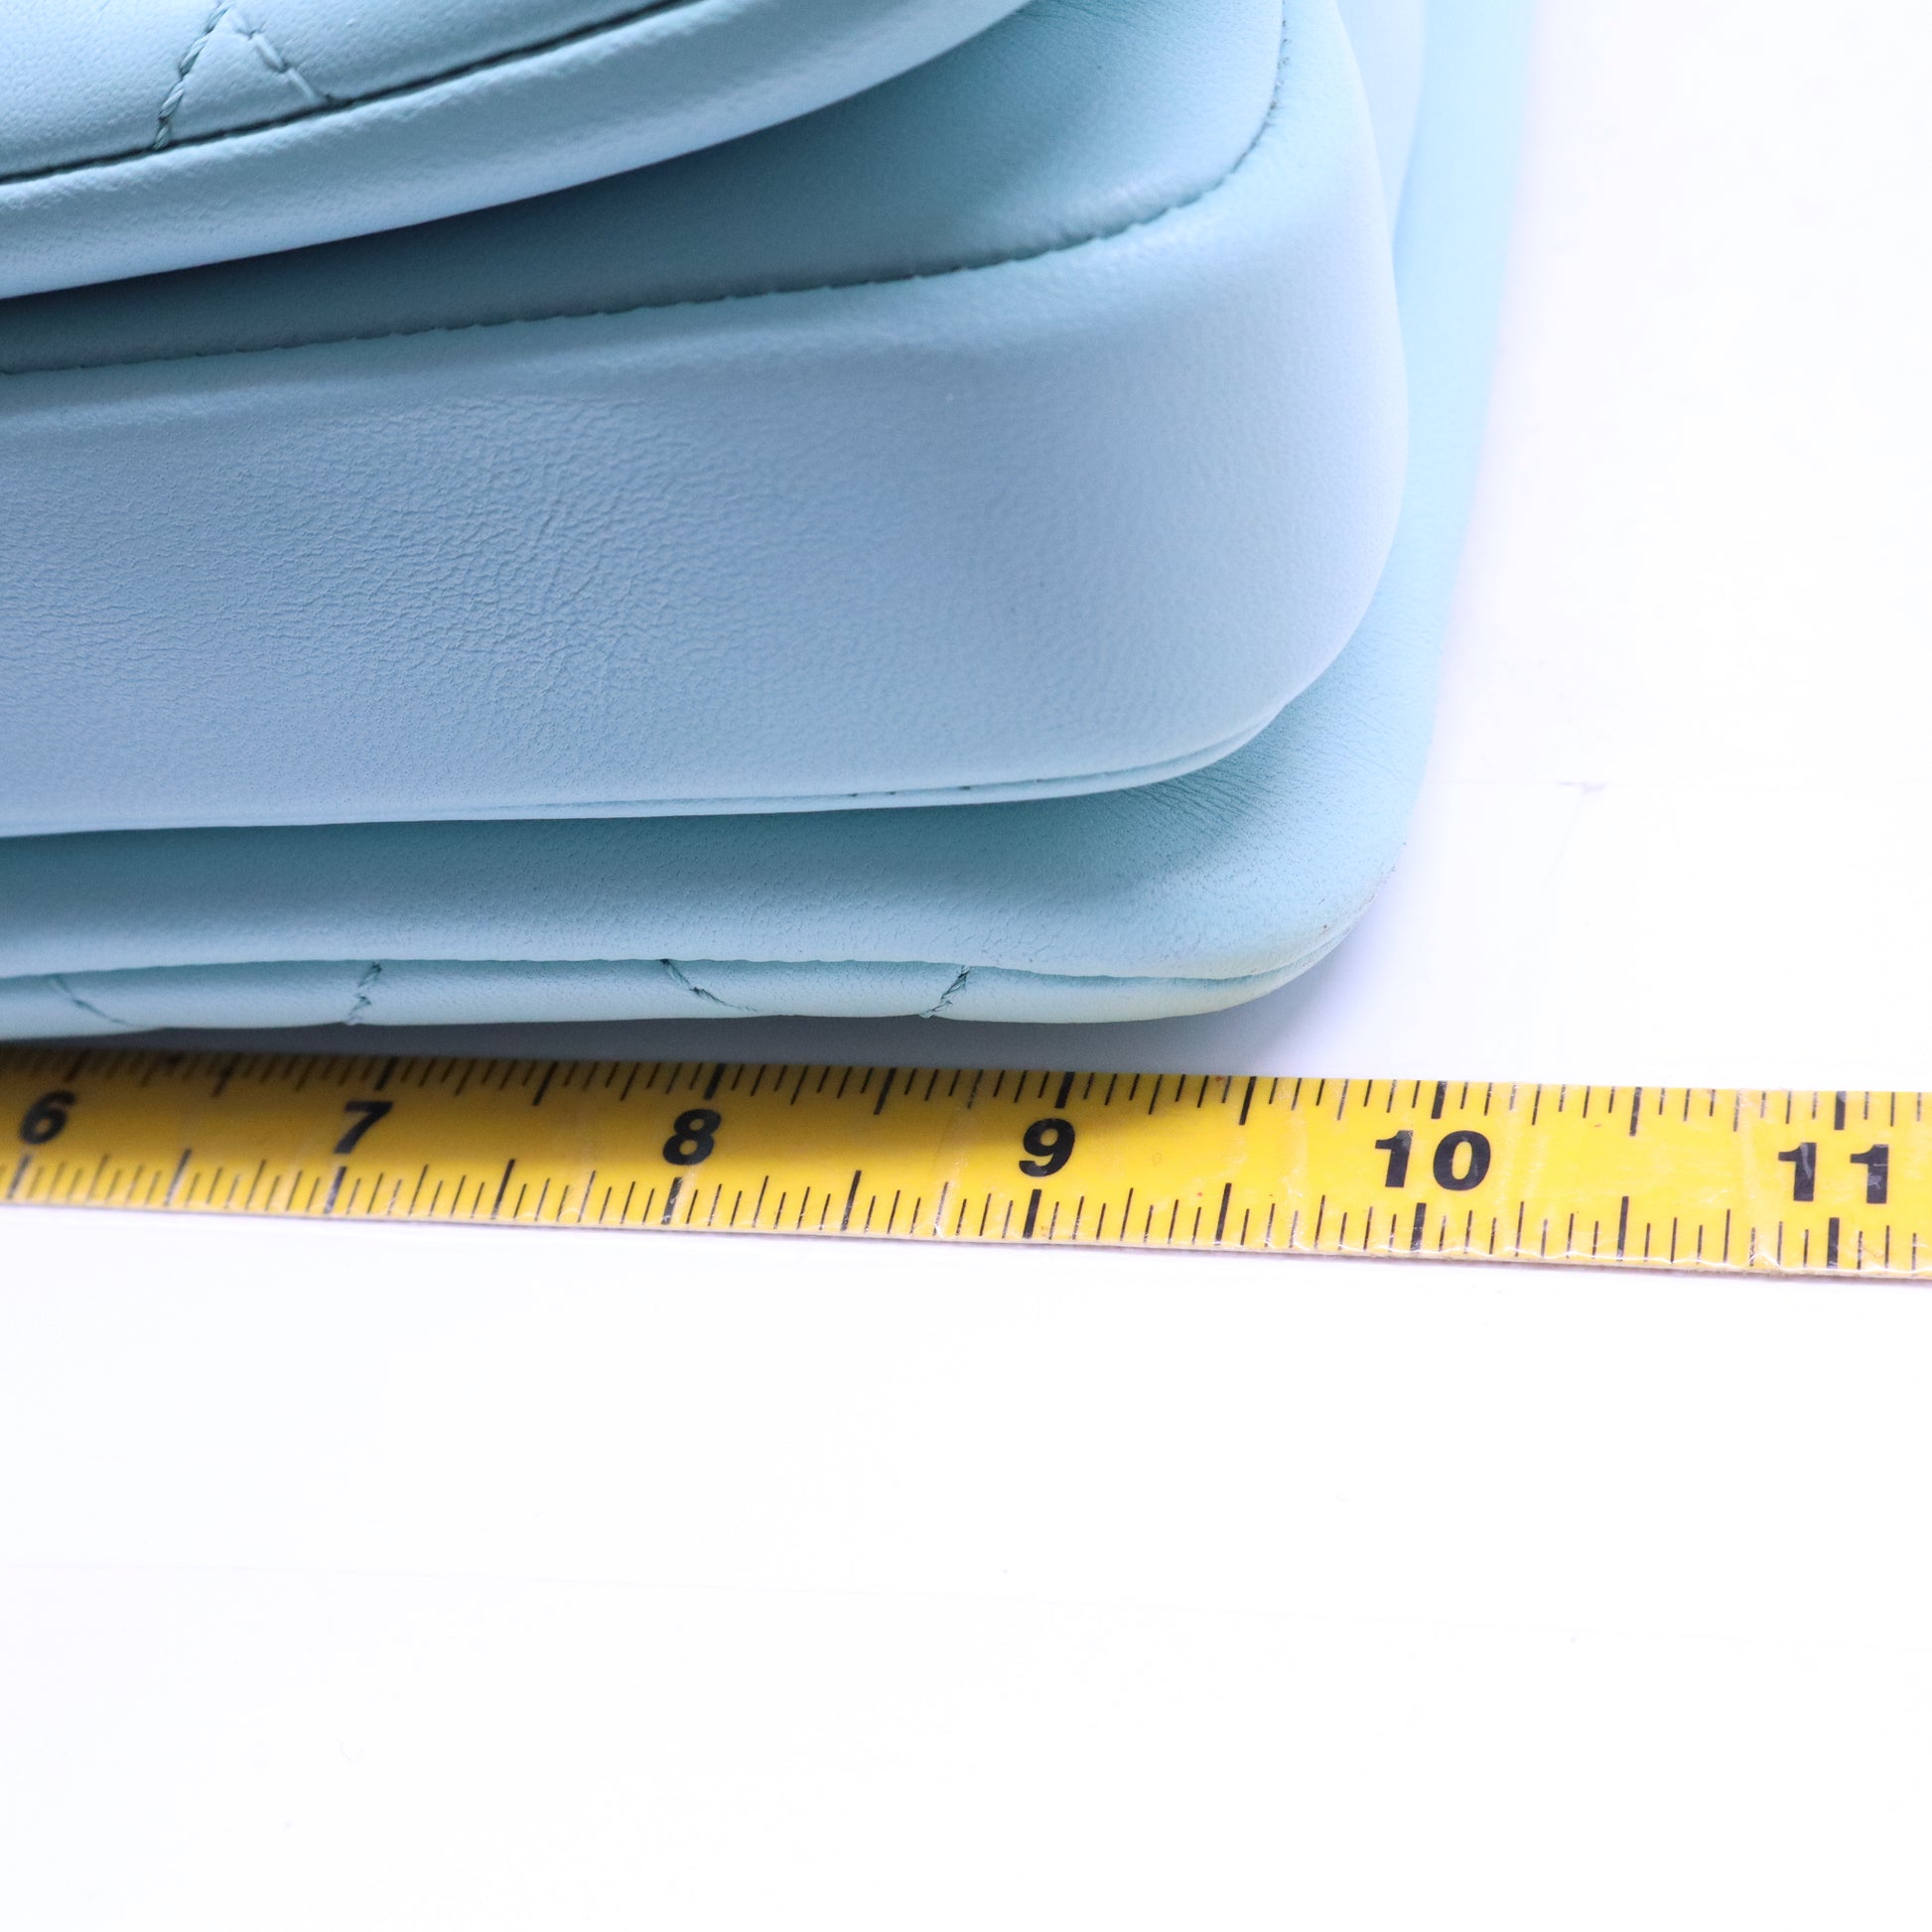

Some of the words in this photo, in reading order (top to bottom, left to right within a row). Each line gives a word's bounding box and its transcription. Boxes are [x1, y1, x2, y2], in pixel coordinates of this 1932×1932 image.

[18, 1090, 76, 1146] 6
[333, 1100, 392, 1155] 7
[661, 1108, 723, 1166] 8
[1019, 1116, 1076, 1177] 9
[1374, 1129, 1492, 1191] 10
[1777, 1142, 1889, 1204] 11
